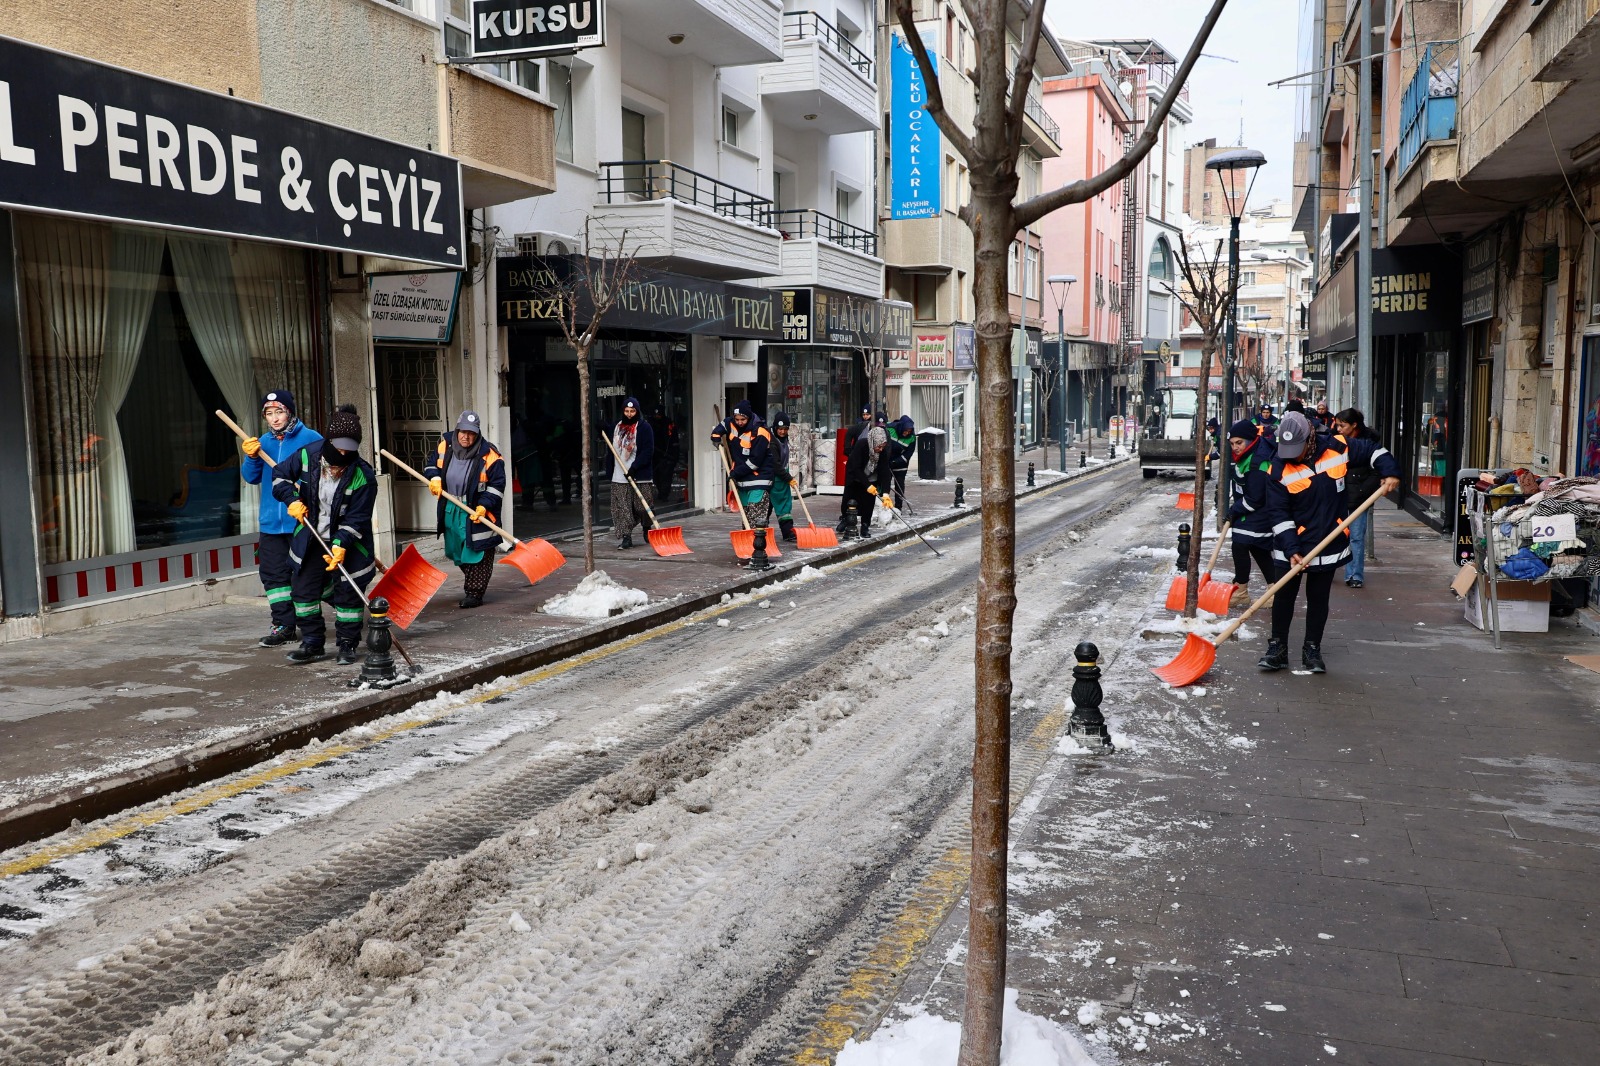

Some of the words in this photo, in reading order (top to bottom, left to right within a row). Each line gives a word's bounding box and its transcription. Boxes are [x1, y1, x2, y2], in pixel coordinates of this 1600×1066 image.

[478, 0, 592, 40] KURSU
[0, 81, 35, 166] L
[58, 94, 262, 204] PERDE
[279, 146, 314, 213] &
[328, 158, 444, 237] ÇEYİZ
[909, 110, 922, 198] OCAKLARI
[902, 200, 930, 209] NEVŞEHİR
[508, 270, 556, 287] BAYAN
[1372, 272, 1431, 294] SİNAN
[373, 290, 390, 307] ÖZEL
[391, 292, 421, 311] ÖZBAŞAK
[420, 298, 450, 312] MOTORLU
[502, 291, 565, 319] TERZİ
[617, 278, 679, 317] NEVRAN
[682, 288, 725, 321] BAYAN
[732, 294, 773, 331] TERZİ
[1371, 293, 1427, 313] PERDE
[372, 311, 390, 322] TAŞIT
[390, 311, 426, 323] SÜRÜCÜLERİ
[427, 316, 446, 324] KURSU
[782, 315, 808, 327] LICI
[829, 297, 875, 334] HALICI
[782, 328, 808, 340] TİH
[918, 353, 945, 367] PERDE
[927, 373, 949, 381] PERDE
[1533, 525, 1555, 538] 20
